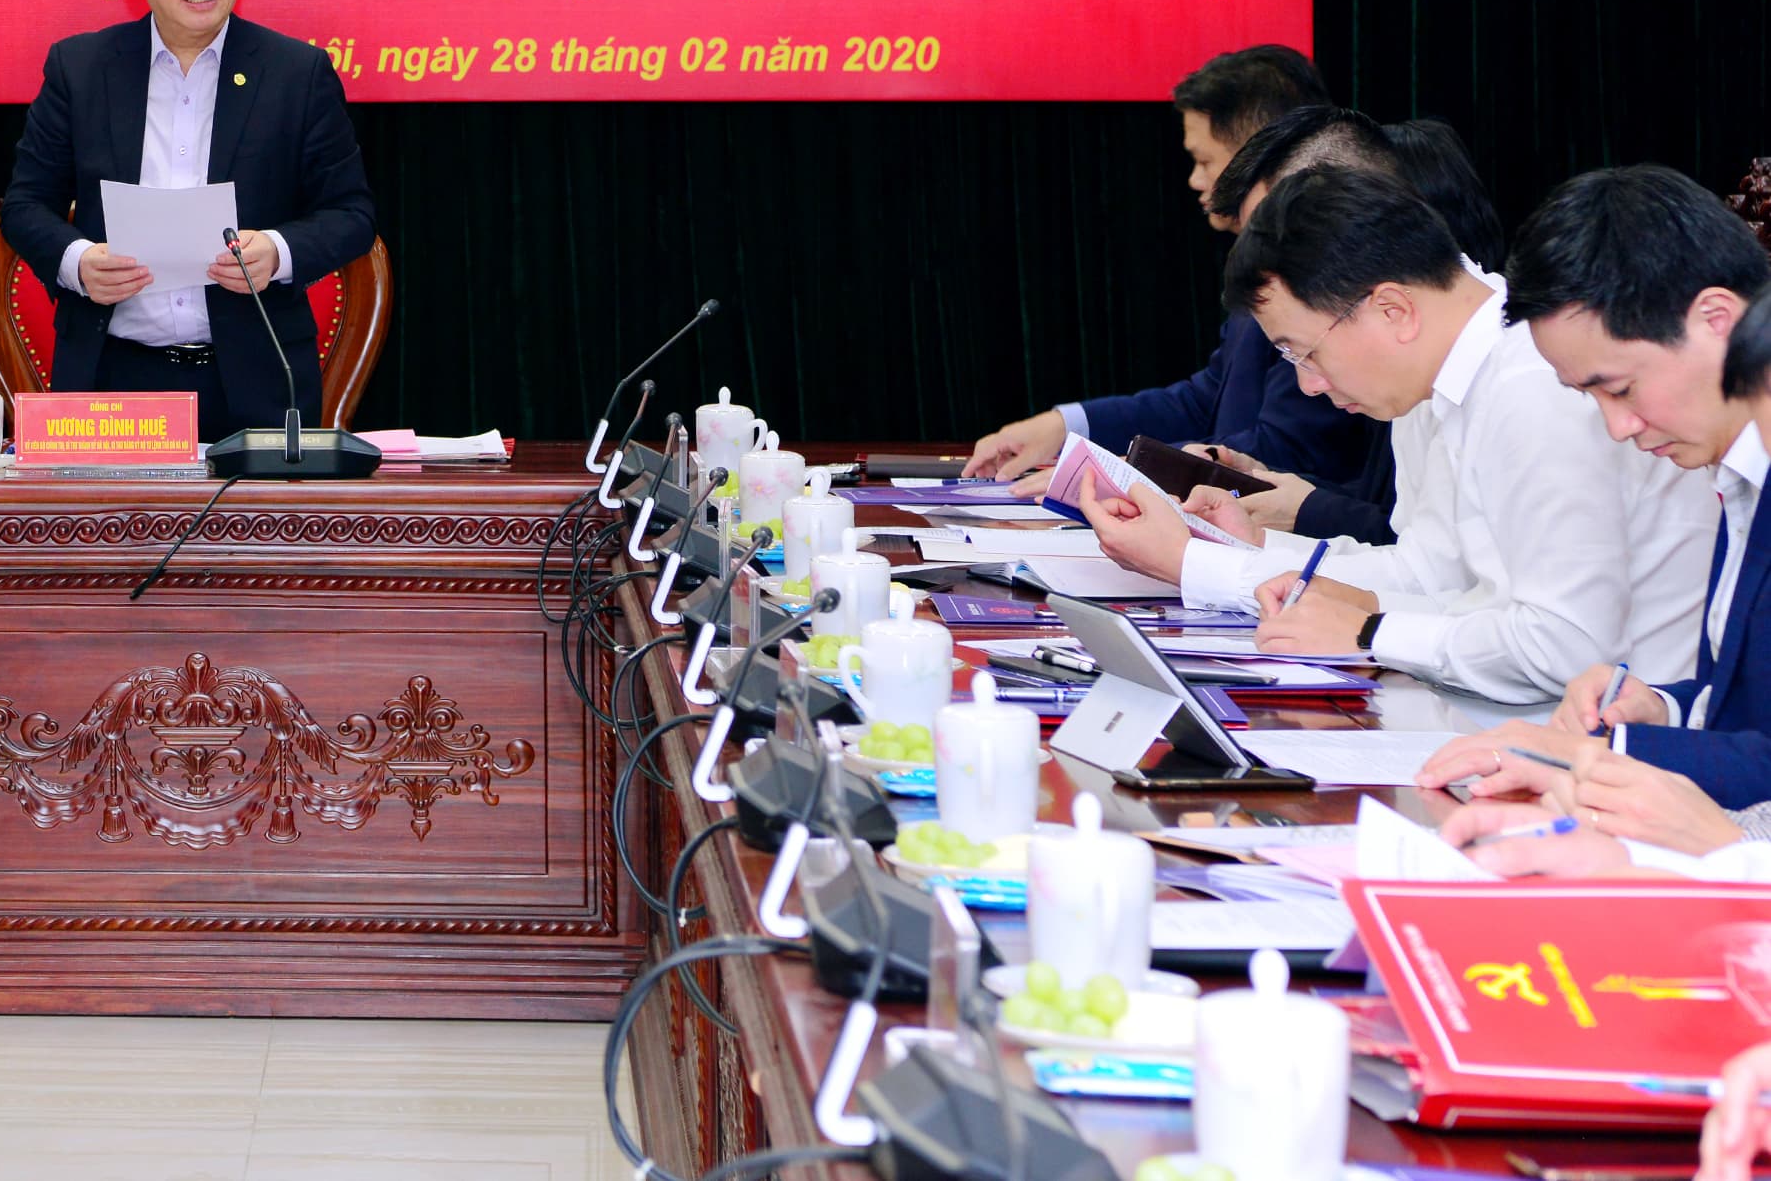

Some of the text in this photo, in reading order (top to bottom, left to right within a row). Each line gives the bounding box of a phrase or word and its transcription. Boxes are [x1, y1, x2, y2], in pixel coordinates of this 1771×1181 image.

[377, 37, 479, 82] ngày
[490, 38, 538, 73] 28
[550, 37, 668, 81] tháng
[679, 37, 729, 72] 02
[739, 38, 829, 72] năm
[842, 36, 941, 72] 2020
[46, 415, 168, 440] VƯƠNG ĐÌNH HUỆ
